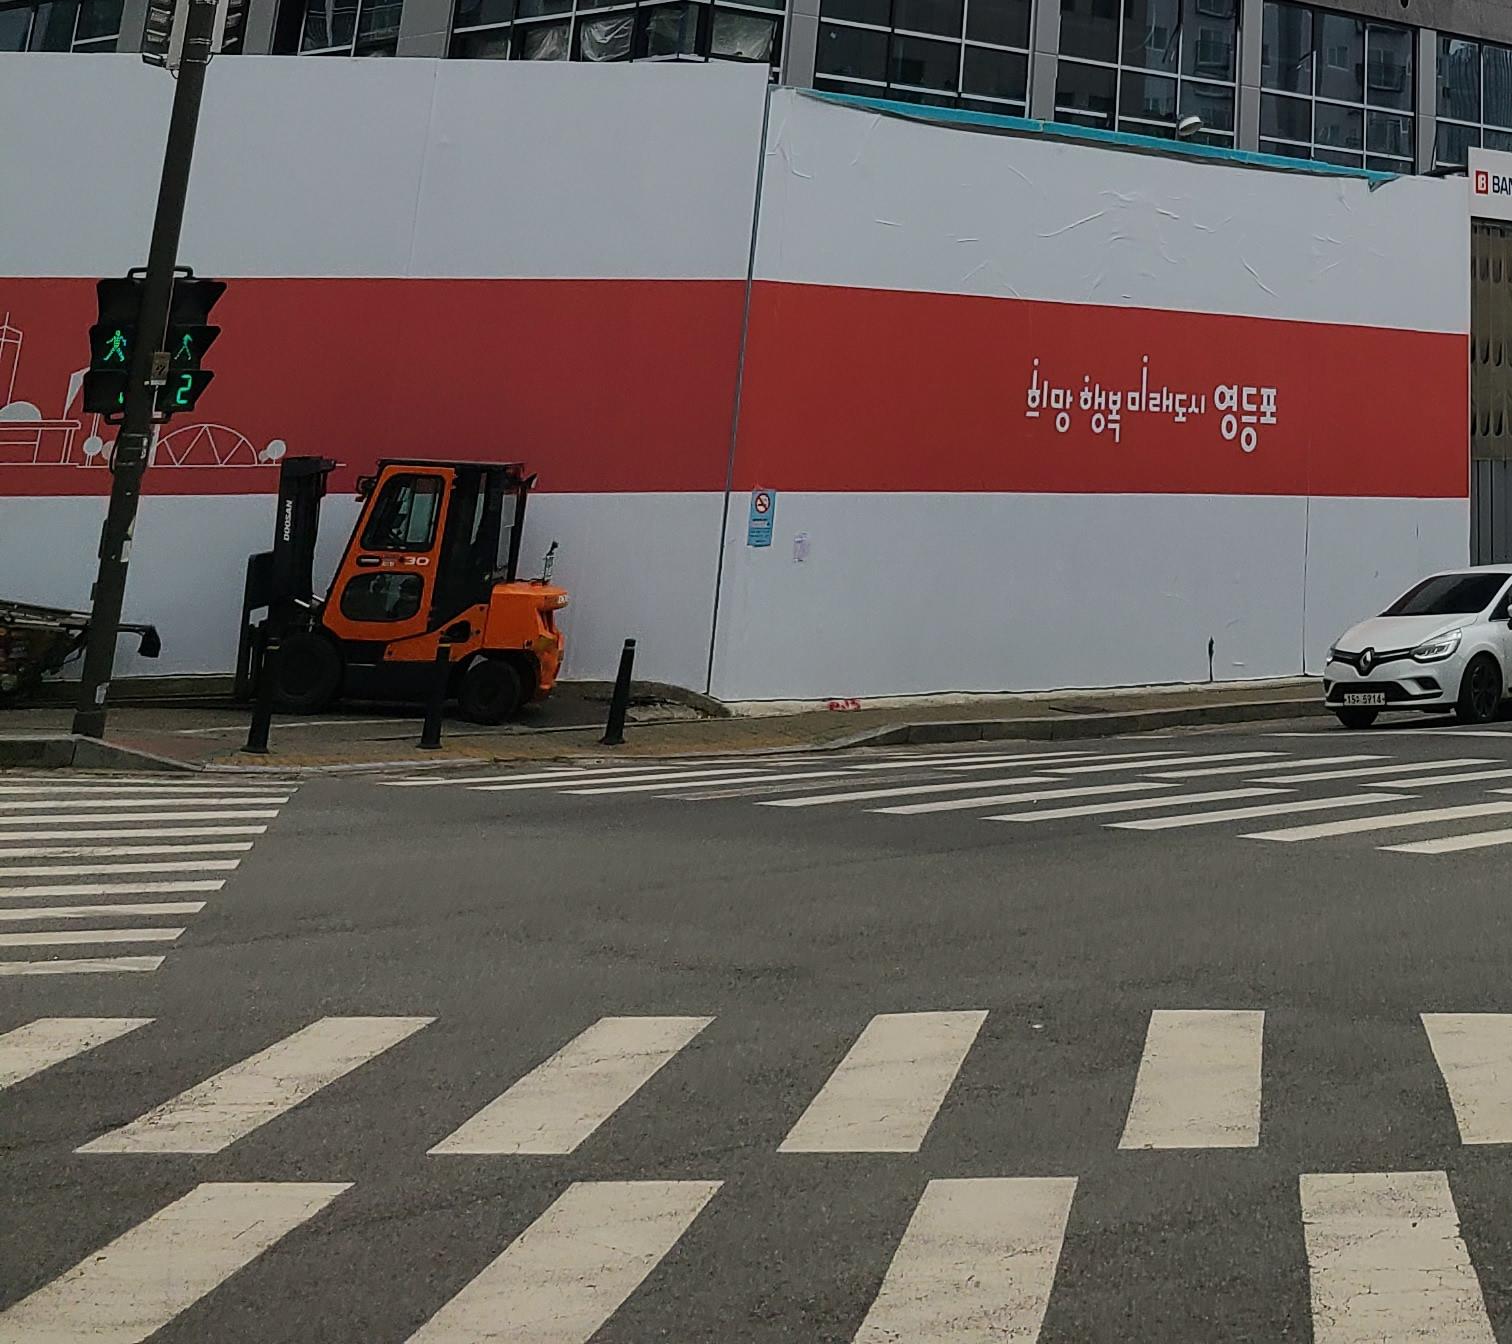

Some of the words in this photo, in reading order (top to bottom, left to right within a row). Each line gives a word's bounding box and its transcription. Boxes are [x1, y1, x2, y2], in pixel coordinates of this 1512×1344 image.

[1025, 358, 1073, 433] 희망
[1079, 375, 1121, 443] 행복
[1126, 355, 1206, 422] 미래도시
[1214, 384, 1277, 453] 영등포
[283, 499, 293, 542] DOOSAN
